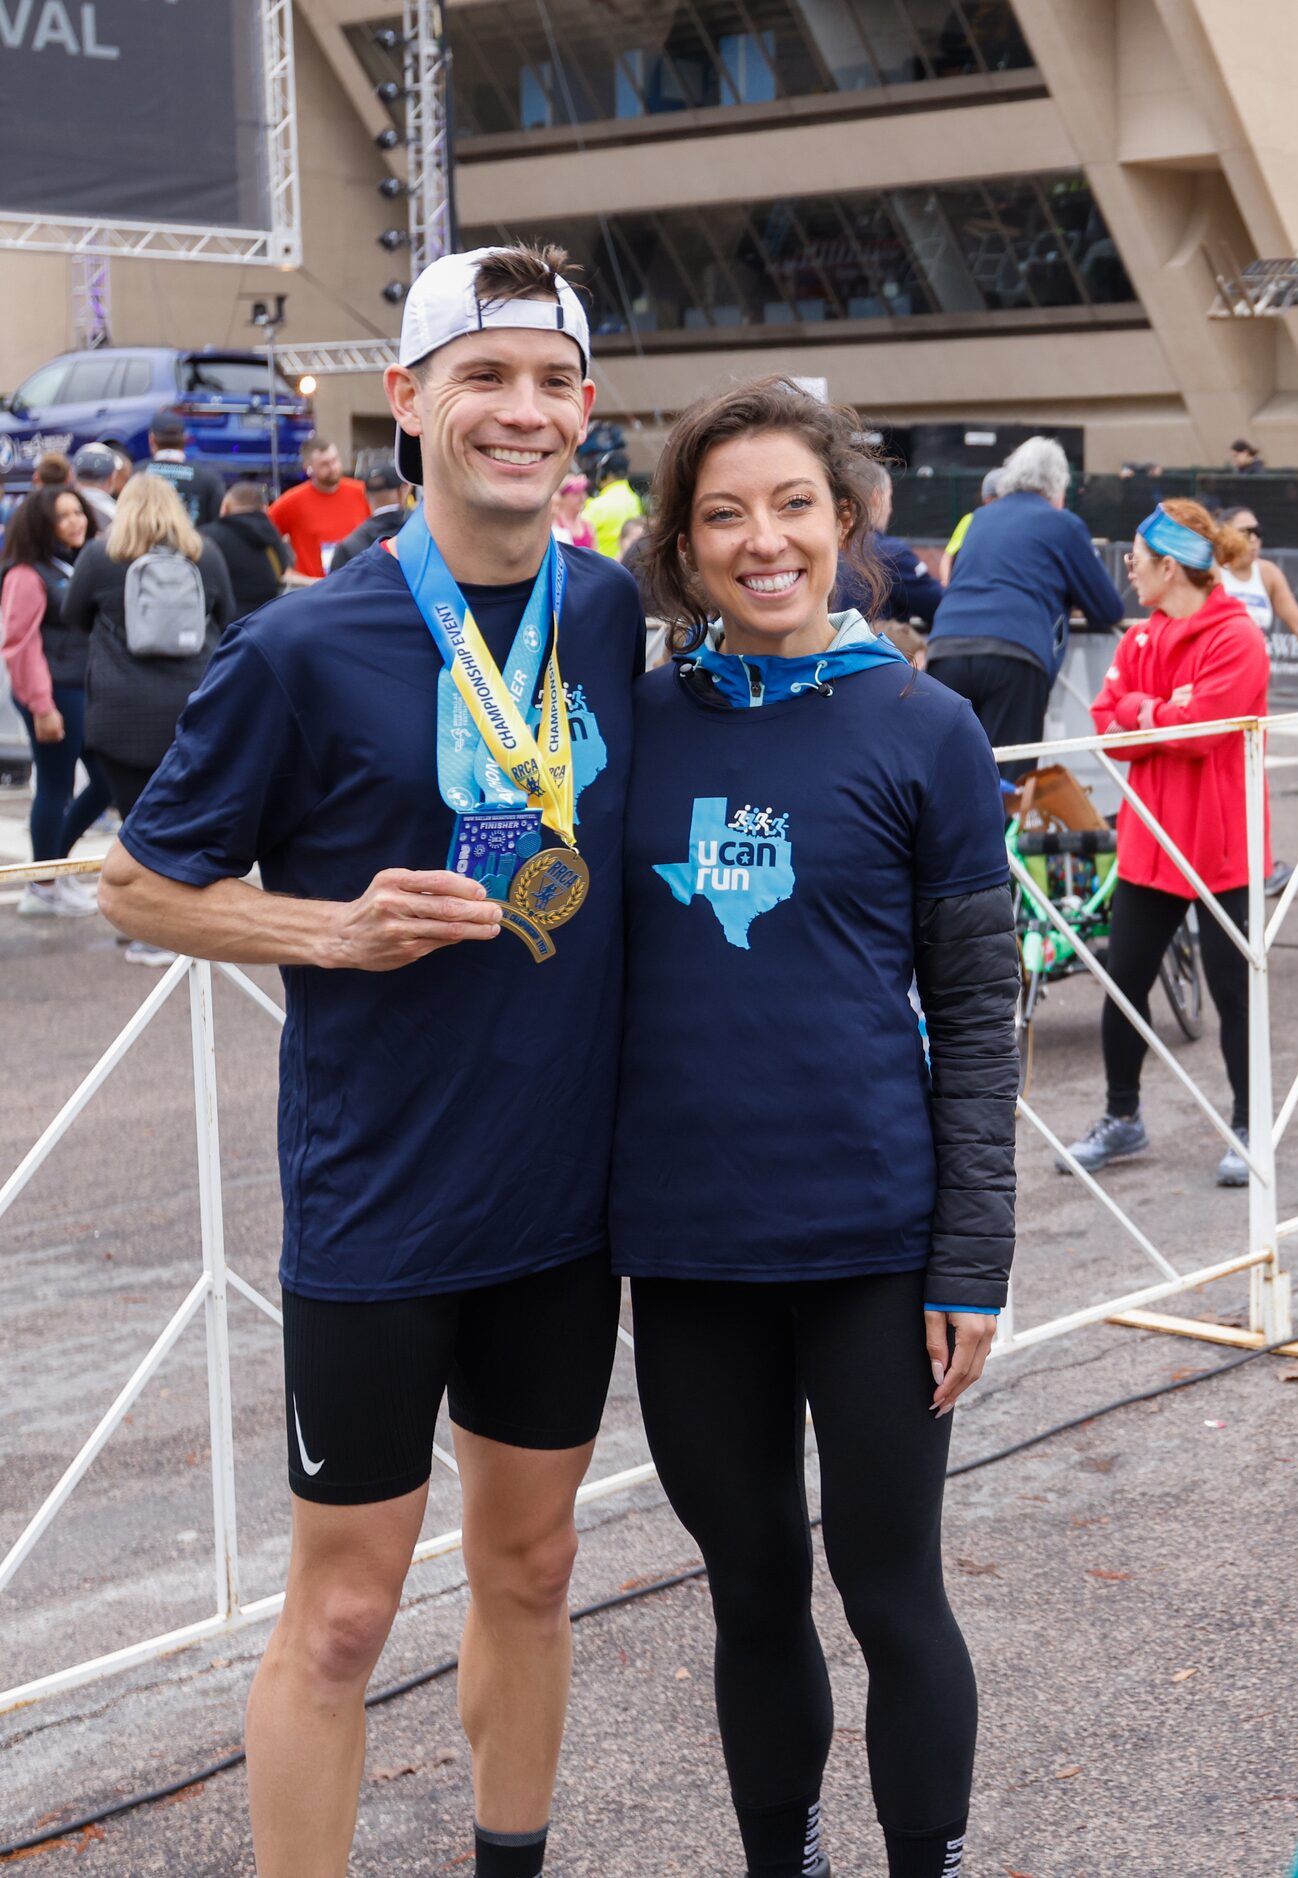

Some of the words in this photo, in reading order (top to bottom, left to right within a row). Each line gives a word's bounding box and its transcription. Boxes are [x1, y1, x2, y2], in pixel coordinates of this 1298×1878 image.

[435, 605, 465, 647] EVENT
[456, 648, 517, 750] CHAMPIONSHIP
[511, 758, 539, 780] RRCA
[480, 821, 519, 829] FINISHER
[546, 860, 582, 890] RRCA
[696, 867, 750, 891] run
